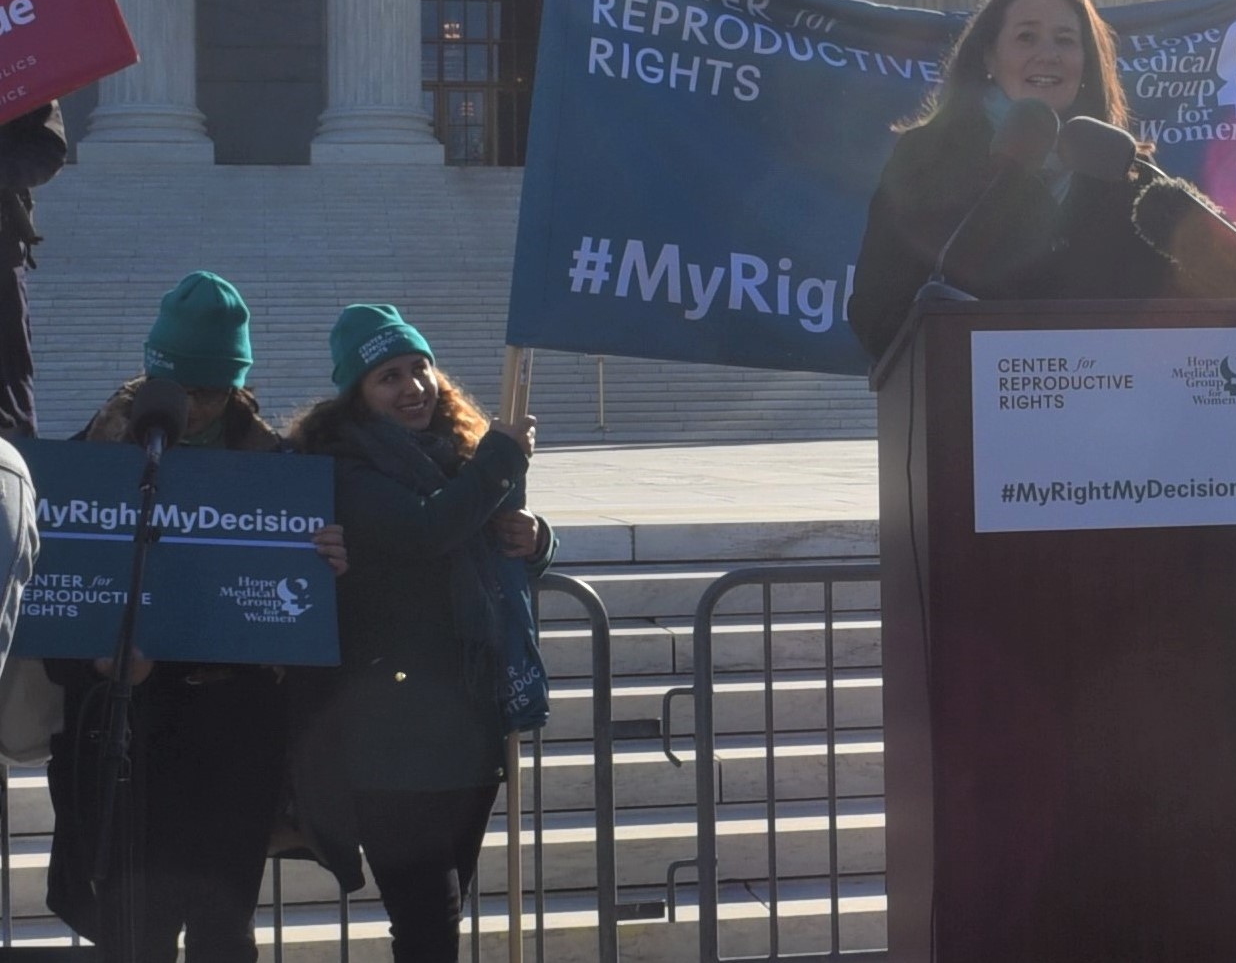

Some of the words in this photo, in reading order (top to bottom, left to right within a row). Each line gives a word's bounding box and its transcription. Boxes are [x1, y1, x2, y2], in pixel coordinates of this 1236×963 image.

[787, 8, 838, 33] for
[1130, 28, 1221, 54] Hope
[588, 37, 762, 101] RIGHTS
[1136, 72, 1215, 107] Group
[1177, 104, 1213, 123] for
[998, 358, 1068, 373] CENTER
[1073, 357, 1096, 373] for
[1187, 356, 1219, 369] Hope
[1171, 367, 1219, 379] Medical
[999, 375, 1133, 391] REPRODUCTIVE
[1185, 377, 1224, 391] Group
[1208, 389, 1222, 397] for
[999, 394, 1065, 410] RIGHTS
[1192, 395, 1236, 406] Women
[34, 498, 325, 534] MyRighMyDecision
[88, 575, 113, 588] for
[238, 576, 276, 589] Hope
[21, 589, 152, 605] EPRODUCTIE
[219, 586, 276, 598] Medical
[236, 596, 282, 610] Group
[21, 604, 78, 618] IGHTS
[244, 612, 296, 623] Women
